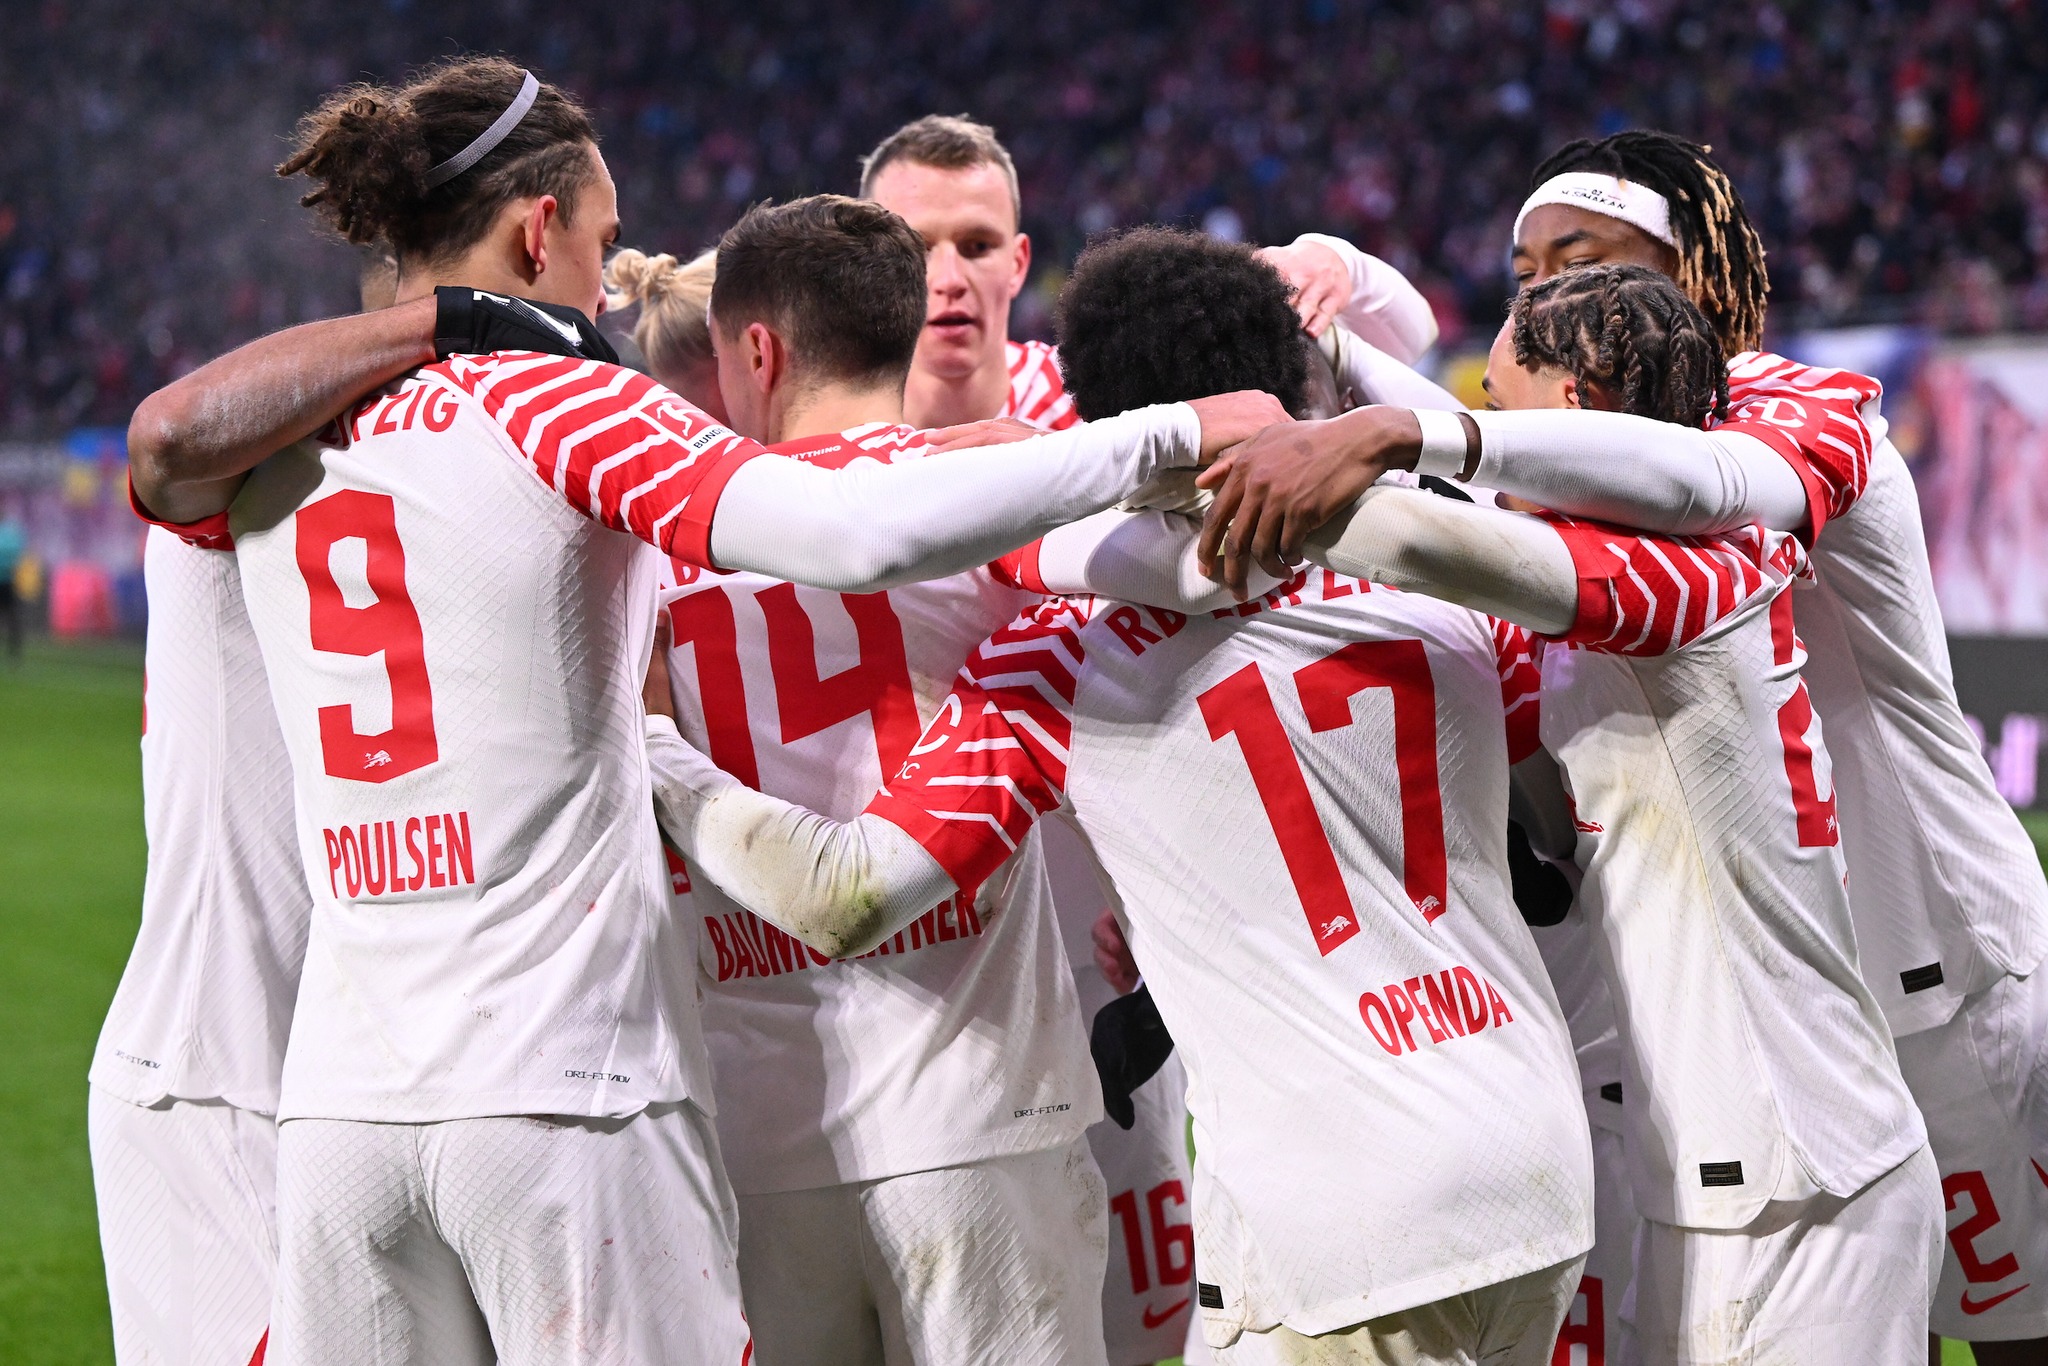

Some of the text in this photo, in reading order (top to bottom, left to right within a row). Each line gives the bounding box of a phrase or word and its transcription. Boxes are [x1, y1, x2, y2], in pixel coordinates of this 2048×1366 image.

[295, 488, 438, 783] 9
[667, 583, 922, 792] 14
[323, 811, 475, 898] POULSEN
[1196, 639, 1448, 957] 17
[1358, 966, 1514, 1056] OPENDA
[1110, 1178, 1194, 1295] 16
[1941, 1170, 2020, 1284] 2
